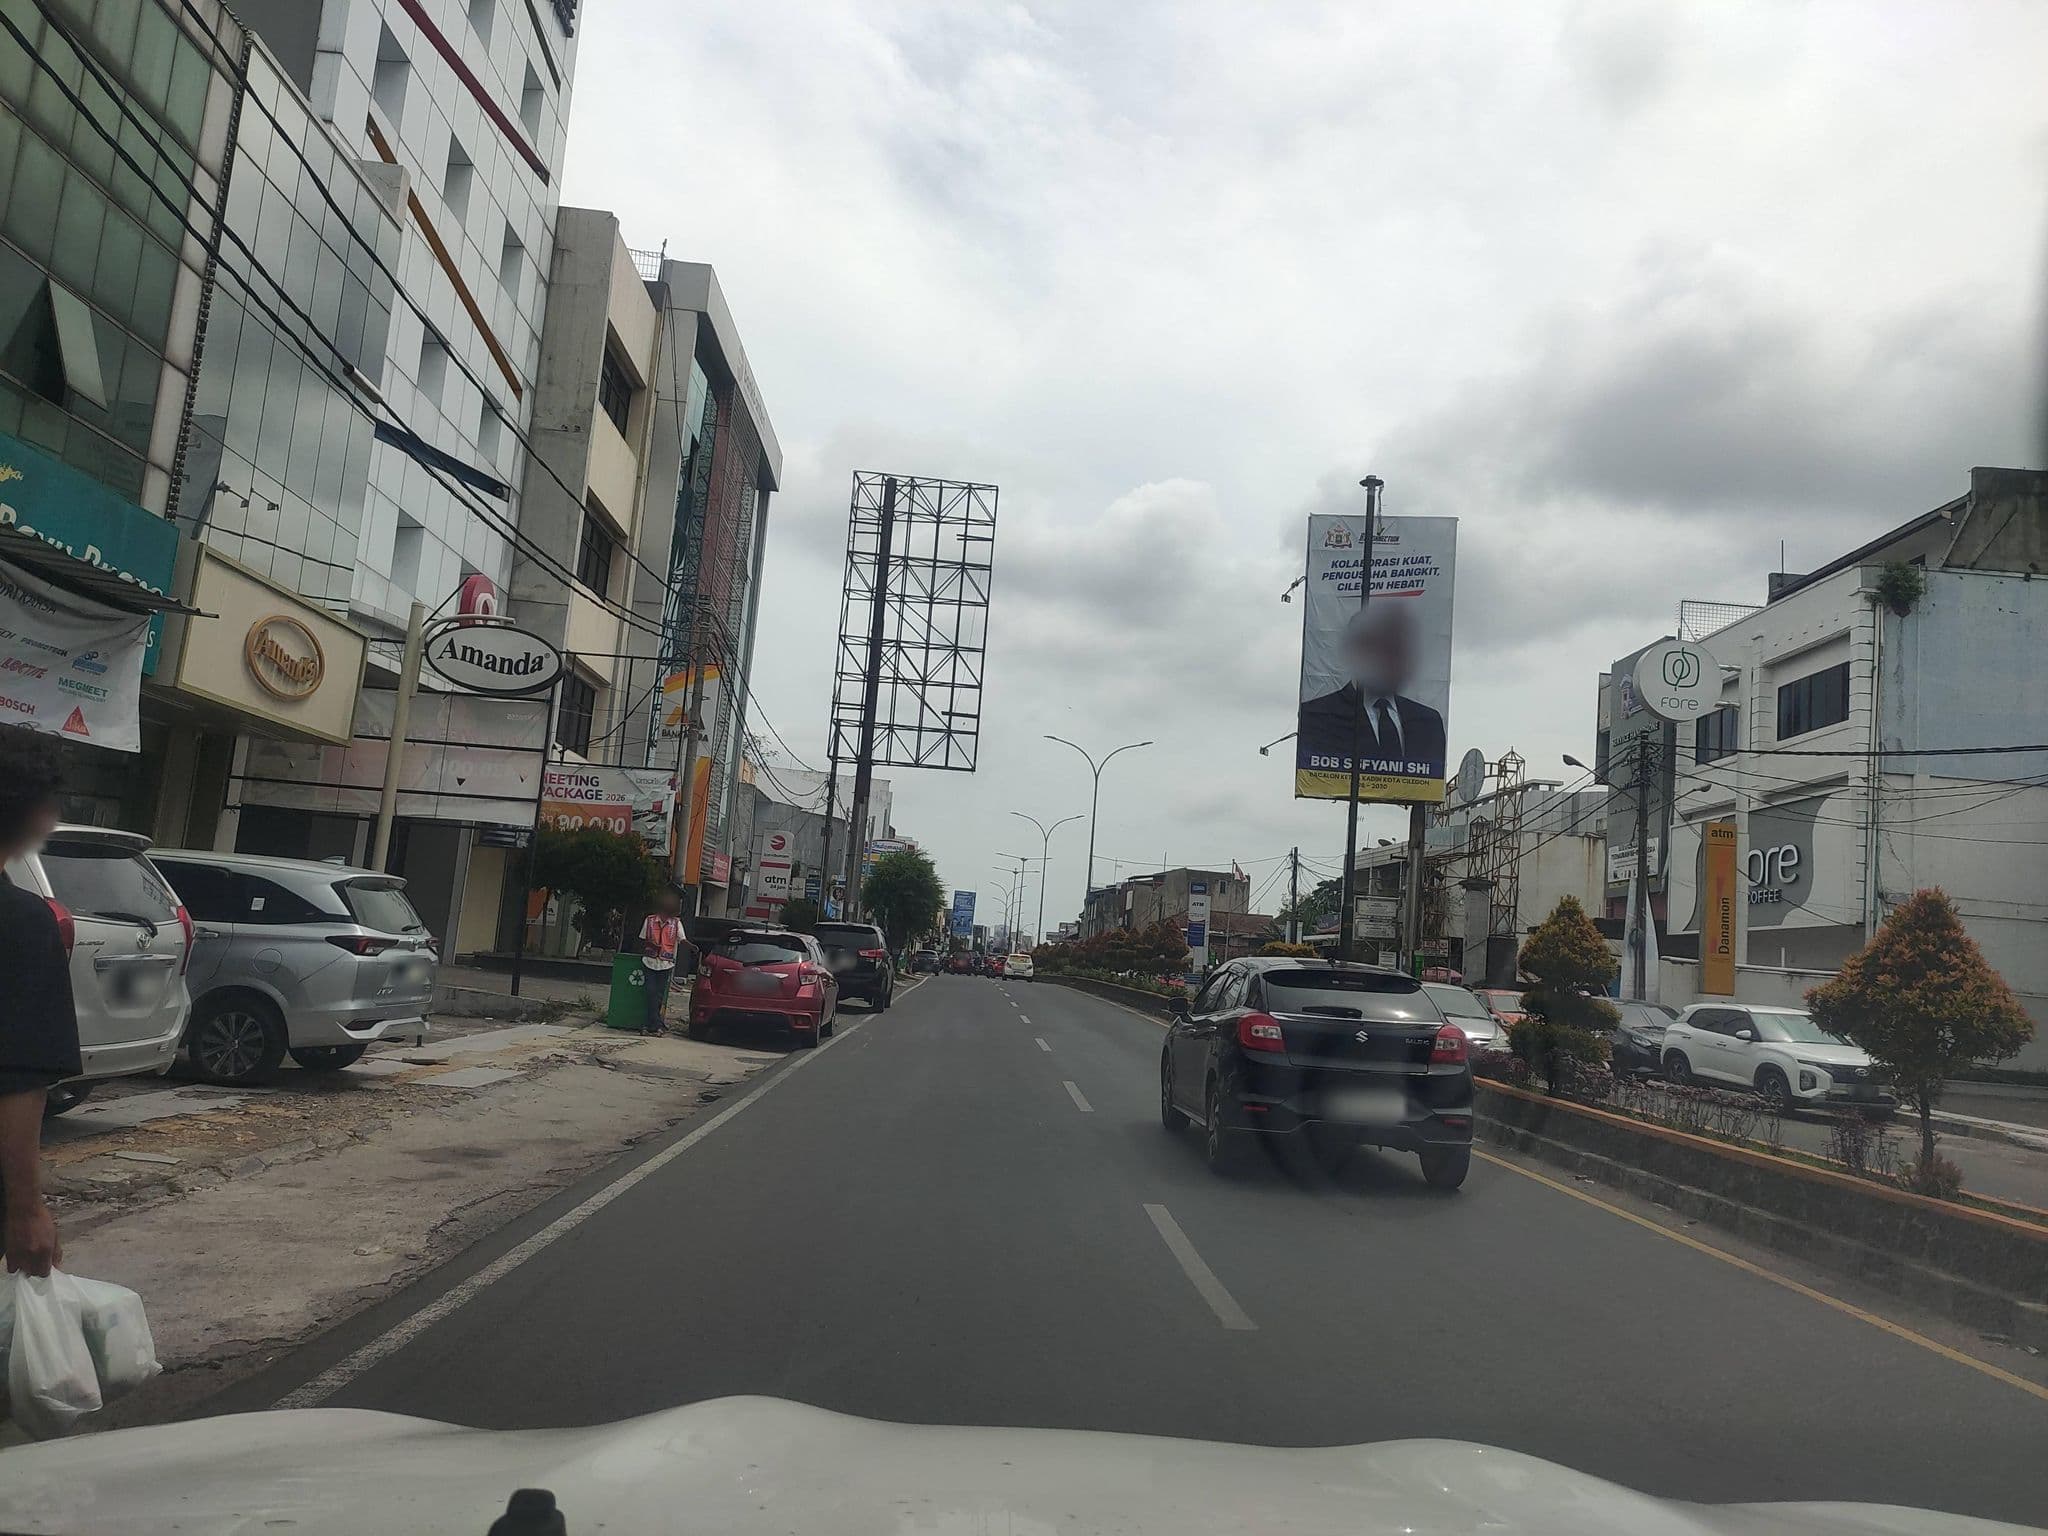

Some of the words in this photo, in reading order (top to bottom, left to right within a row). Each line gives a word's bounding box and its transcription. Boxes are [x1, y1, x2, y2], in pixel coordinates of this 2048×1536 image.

[1337, 581, 1384, 591] CILEON
[436, 638, 544, 675] Amanda
[0, 696, 36, 715] BOSCH
[1310, 755, 1339, 768] BOB
[543, 787, 603, 801] ACKAGE
[606, 794, 626, 802] 2026
[1711, 828, 1733, 838] atm
[1748, 844, 1798, 887] ore
[765, 875, 787, 884] atm
[1718, 897, 1730, 955] Danamon
